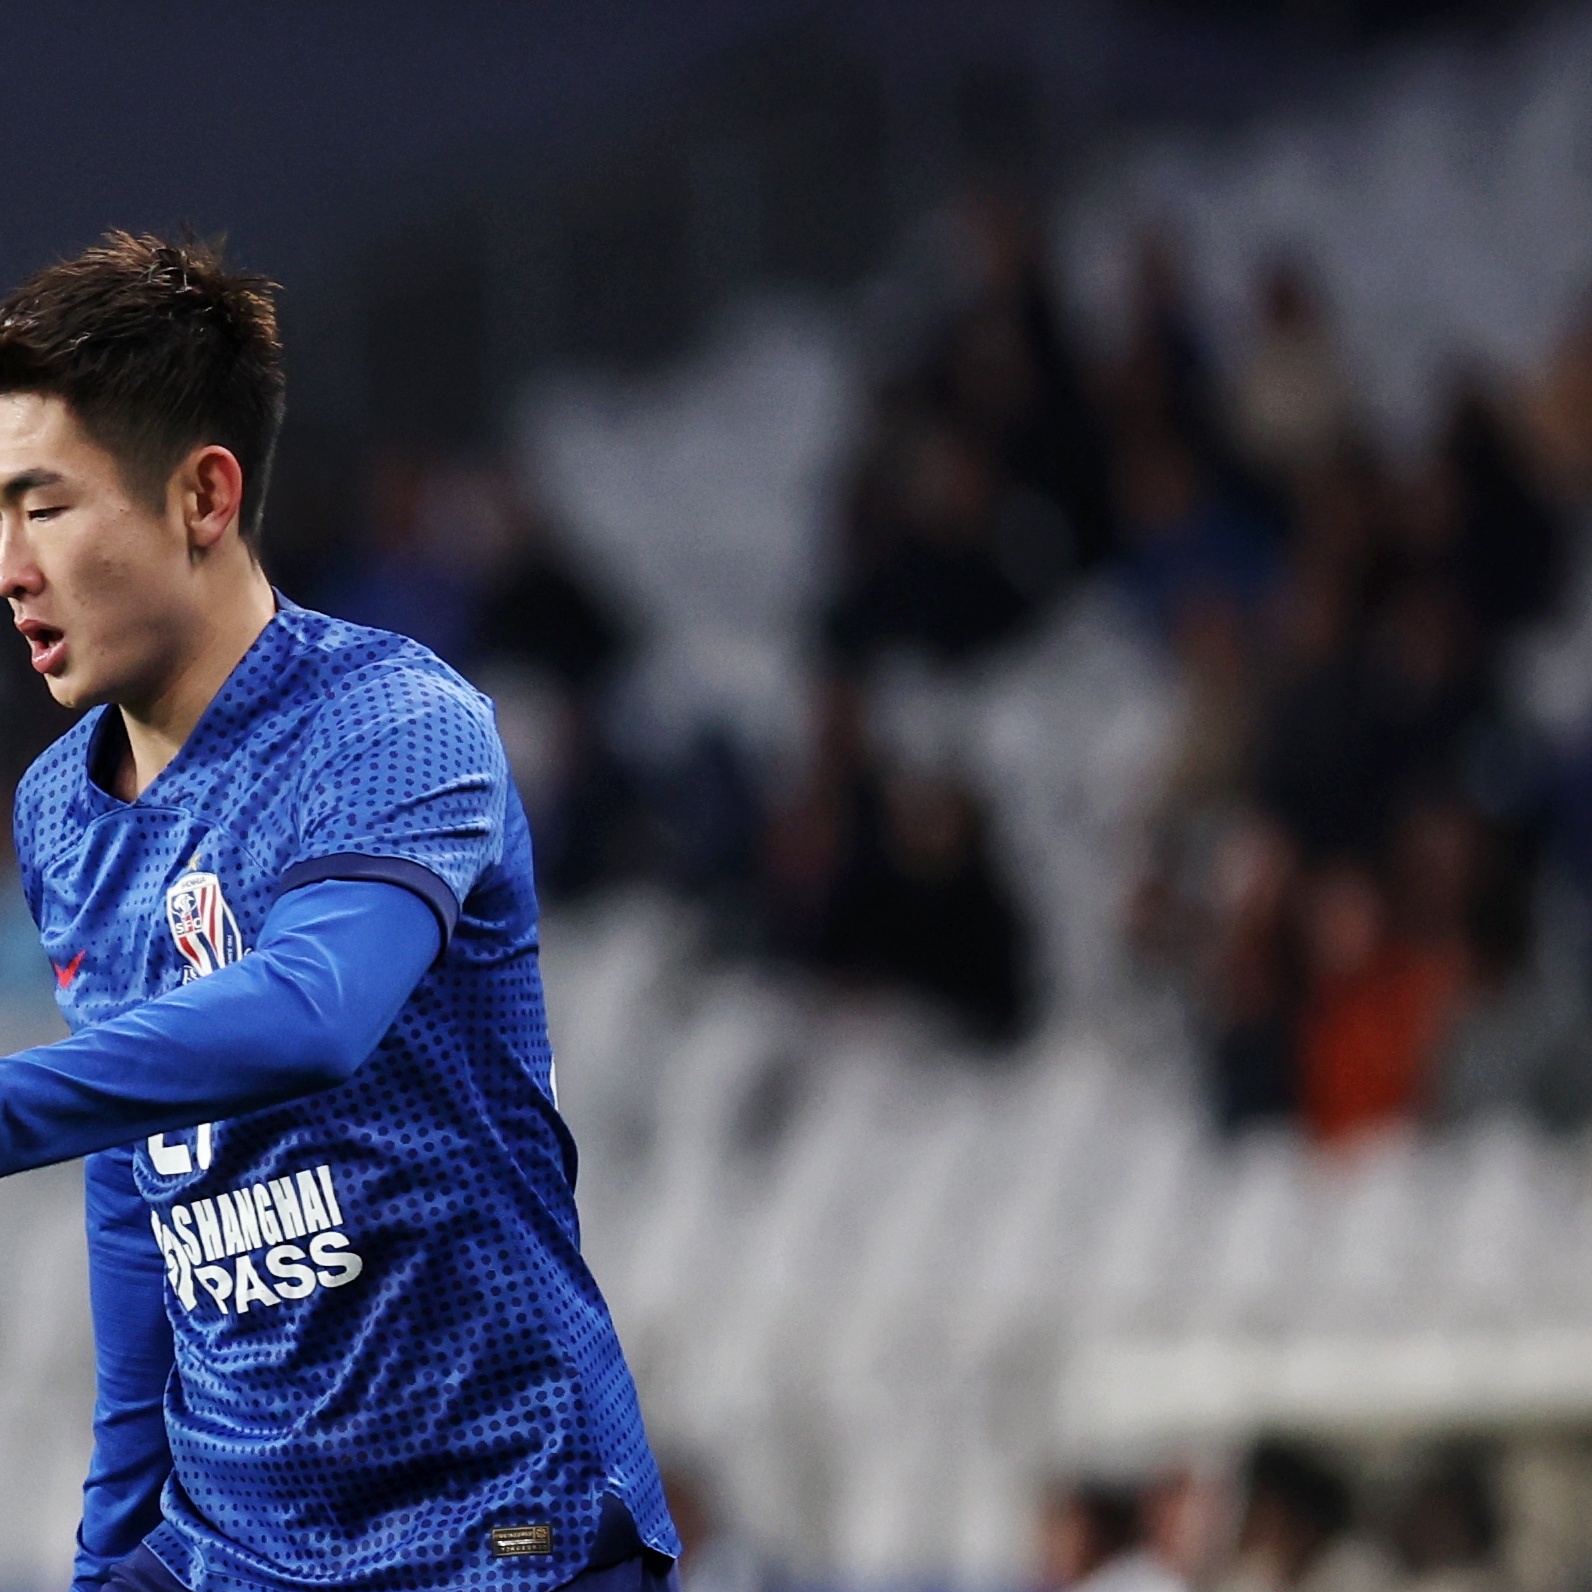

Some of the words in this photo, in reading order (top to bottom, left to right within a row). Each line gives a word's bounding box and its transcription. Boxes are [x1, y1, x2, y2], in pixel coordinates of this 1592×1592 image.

[176, 917, 202, 934] SFC
[171, 1164, 344, 1266] SHANGHAI
[193, 1231, 364, 1314] PASS
